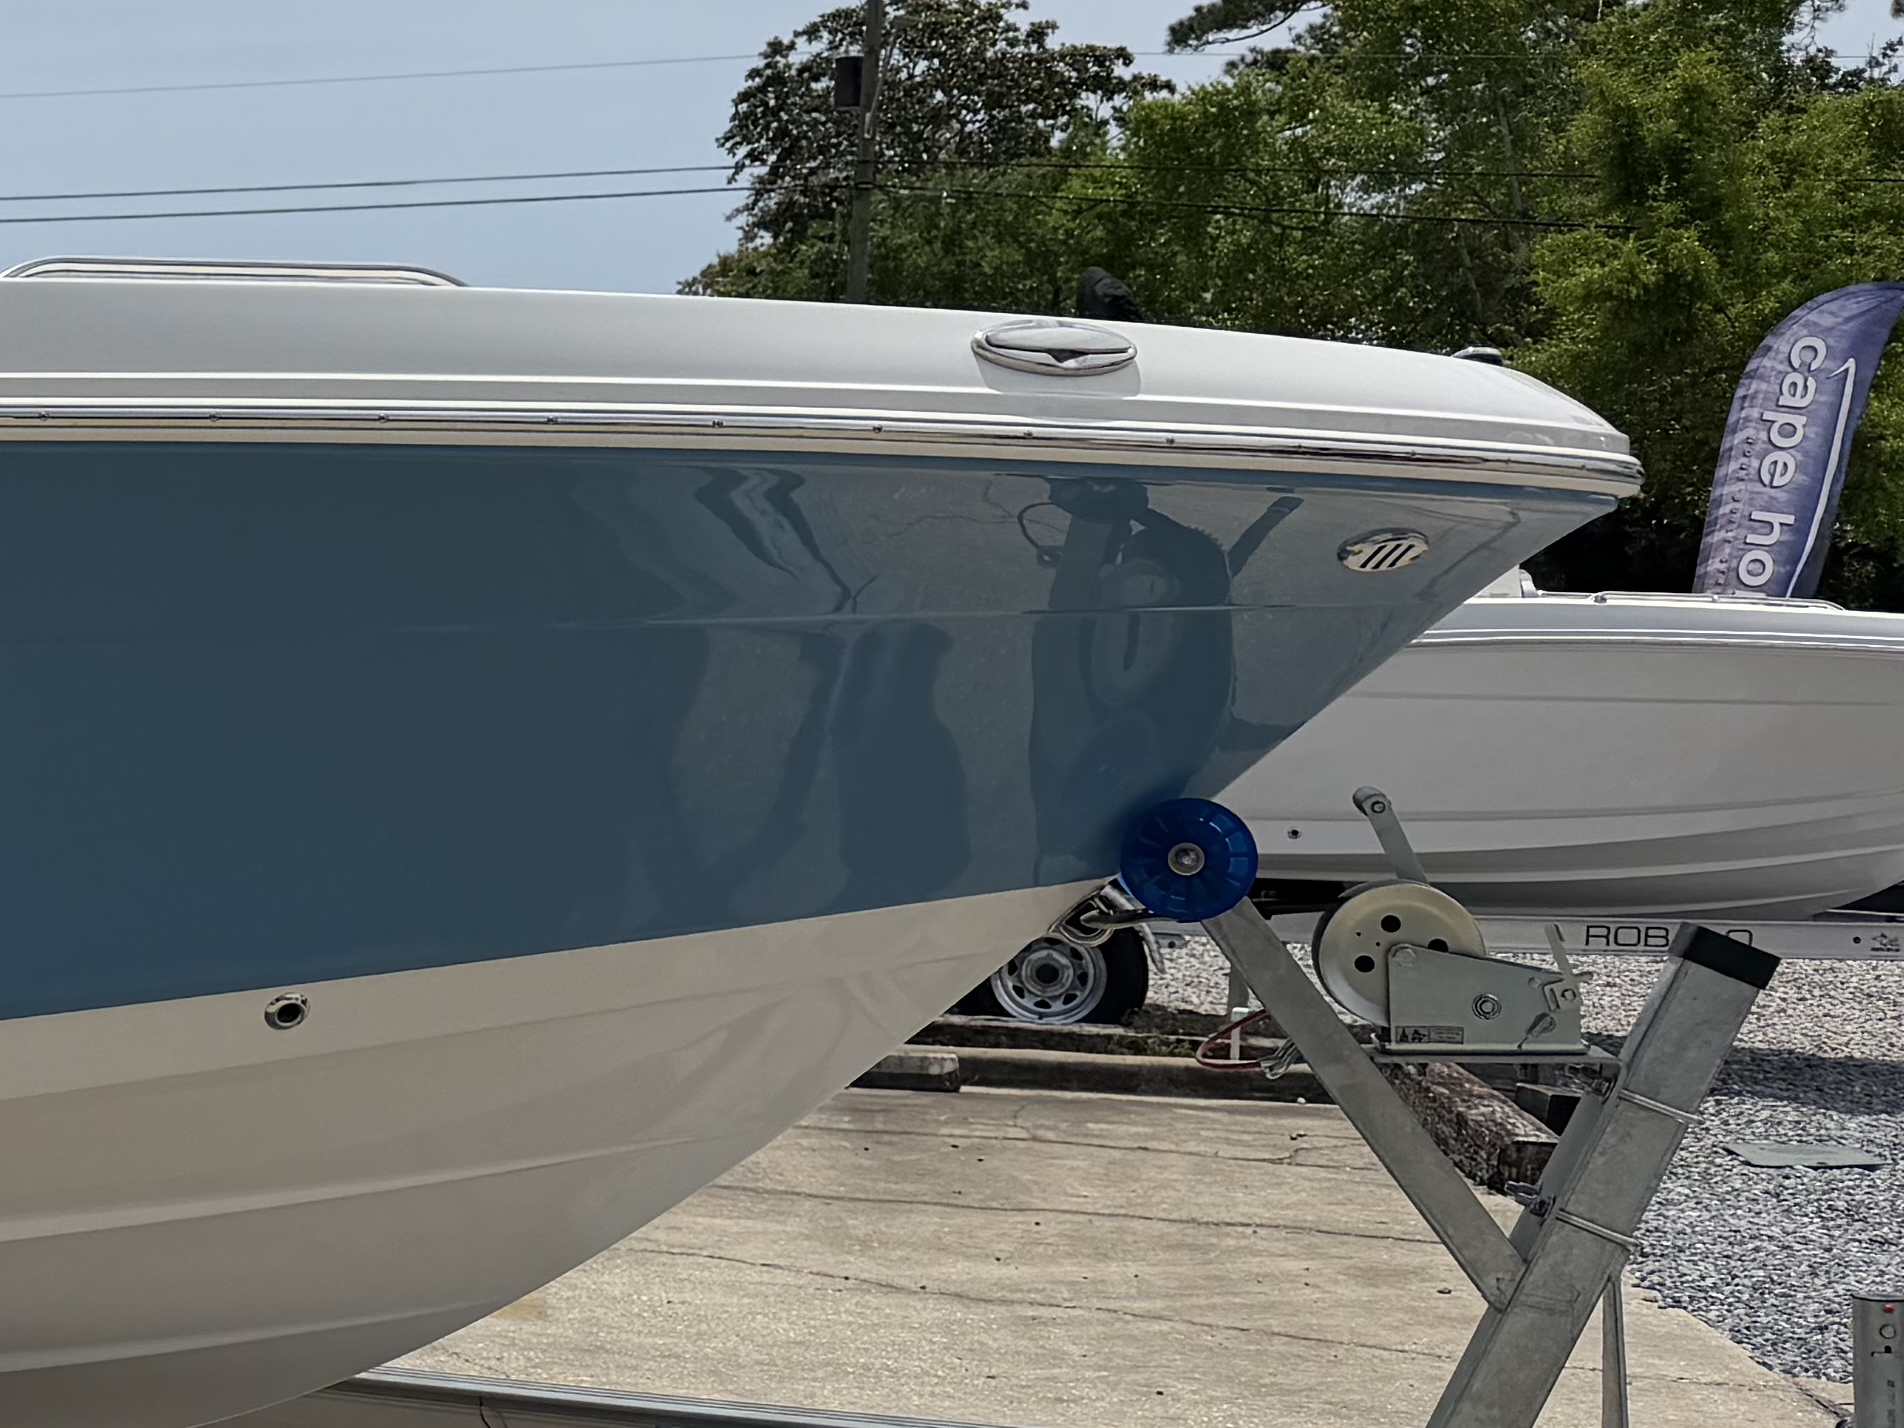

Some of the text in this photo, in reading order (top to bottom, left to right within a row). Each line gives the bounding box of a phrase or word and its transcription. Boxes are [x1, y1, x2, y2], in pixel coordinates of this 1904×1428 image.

[1736, 335, 1828, 596] cape ho
[1584, 925, 1753, 948] ROBO
